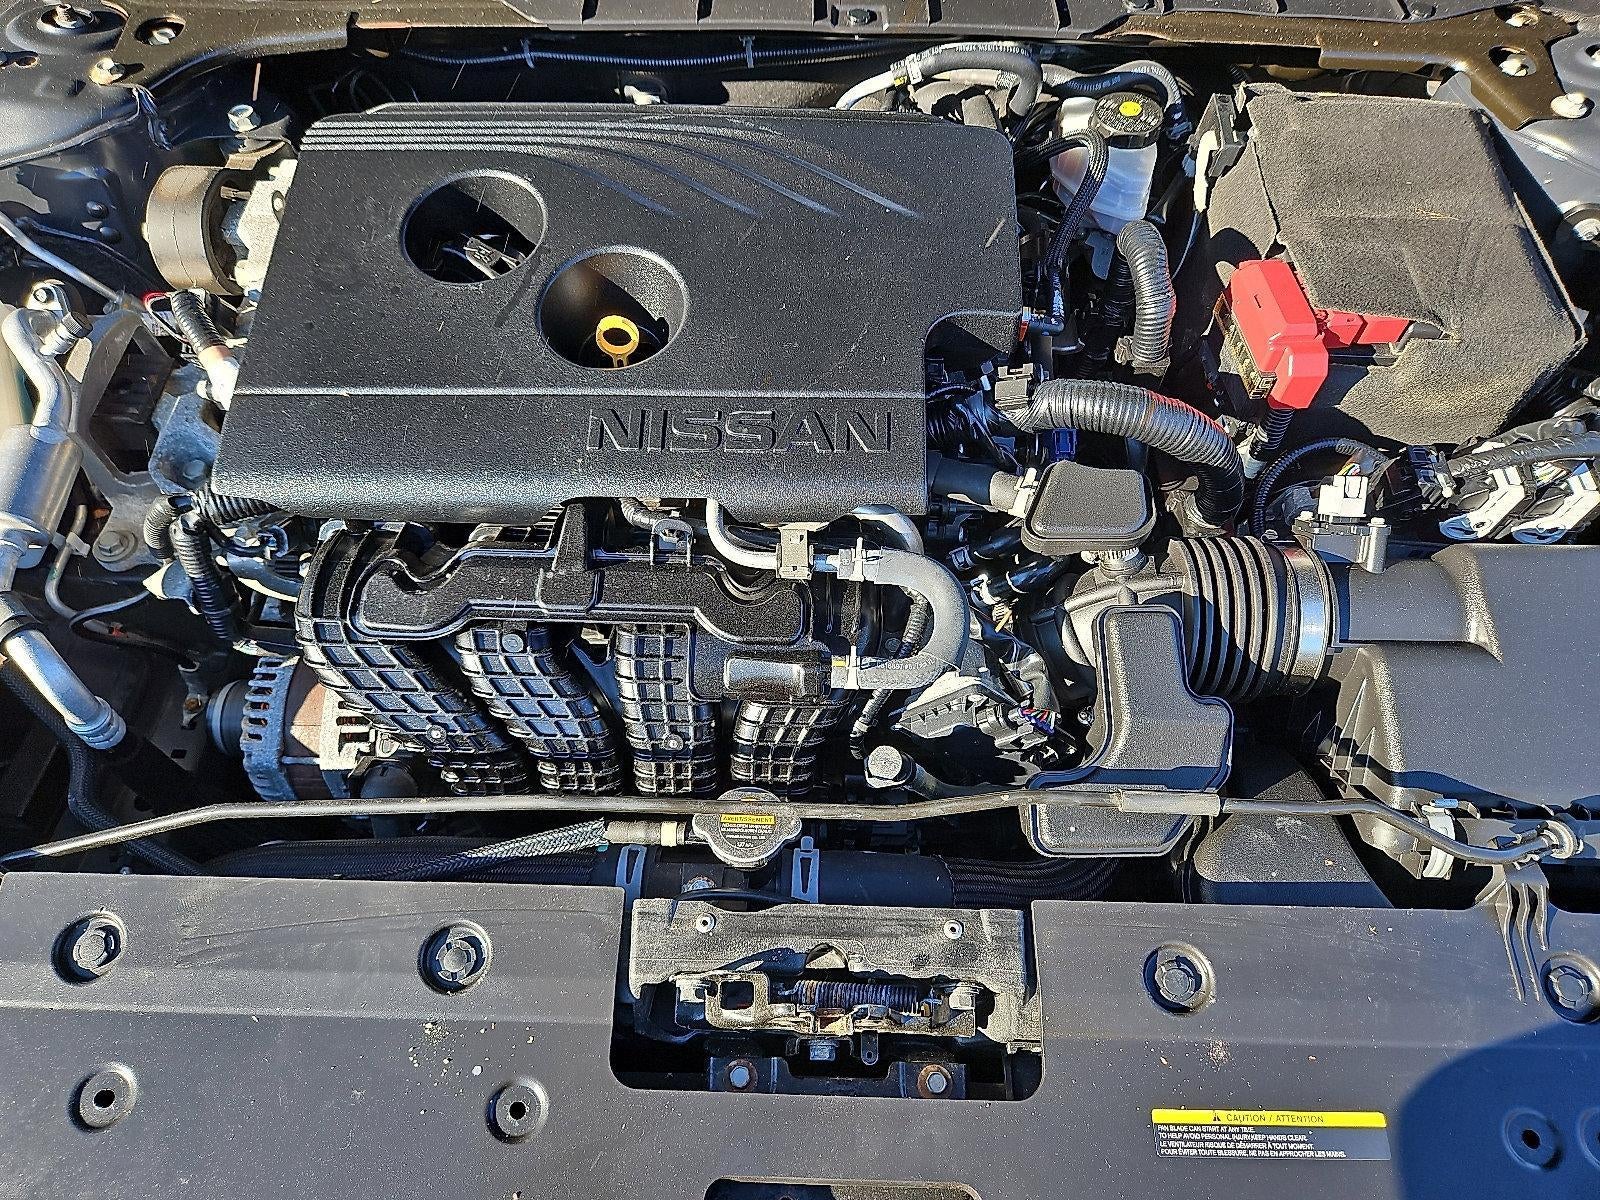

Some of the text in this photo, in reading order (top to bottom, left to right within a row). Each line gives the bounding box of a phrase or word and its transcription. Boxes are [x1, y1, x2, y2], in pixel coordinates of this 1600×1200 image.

[586, 408, 892, 453] NISSAN
[1226, 1114, 1266, 1122] CAUTION
[1276, 1115, 1324, 1123] ATTENTION
